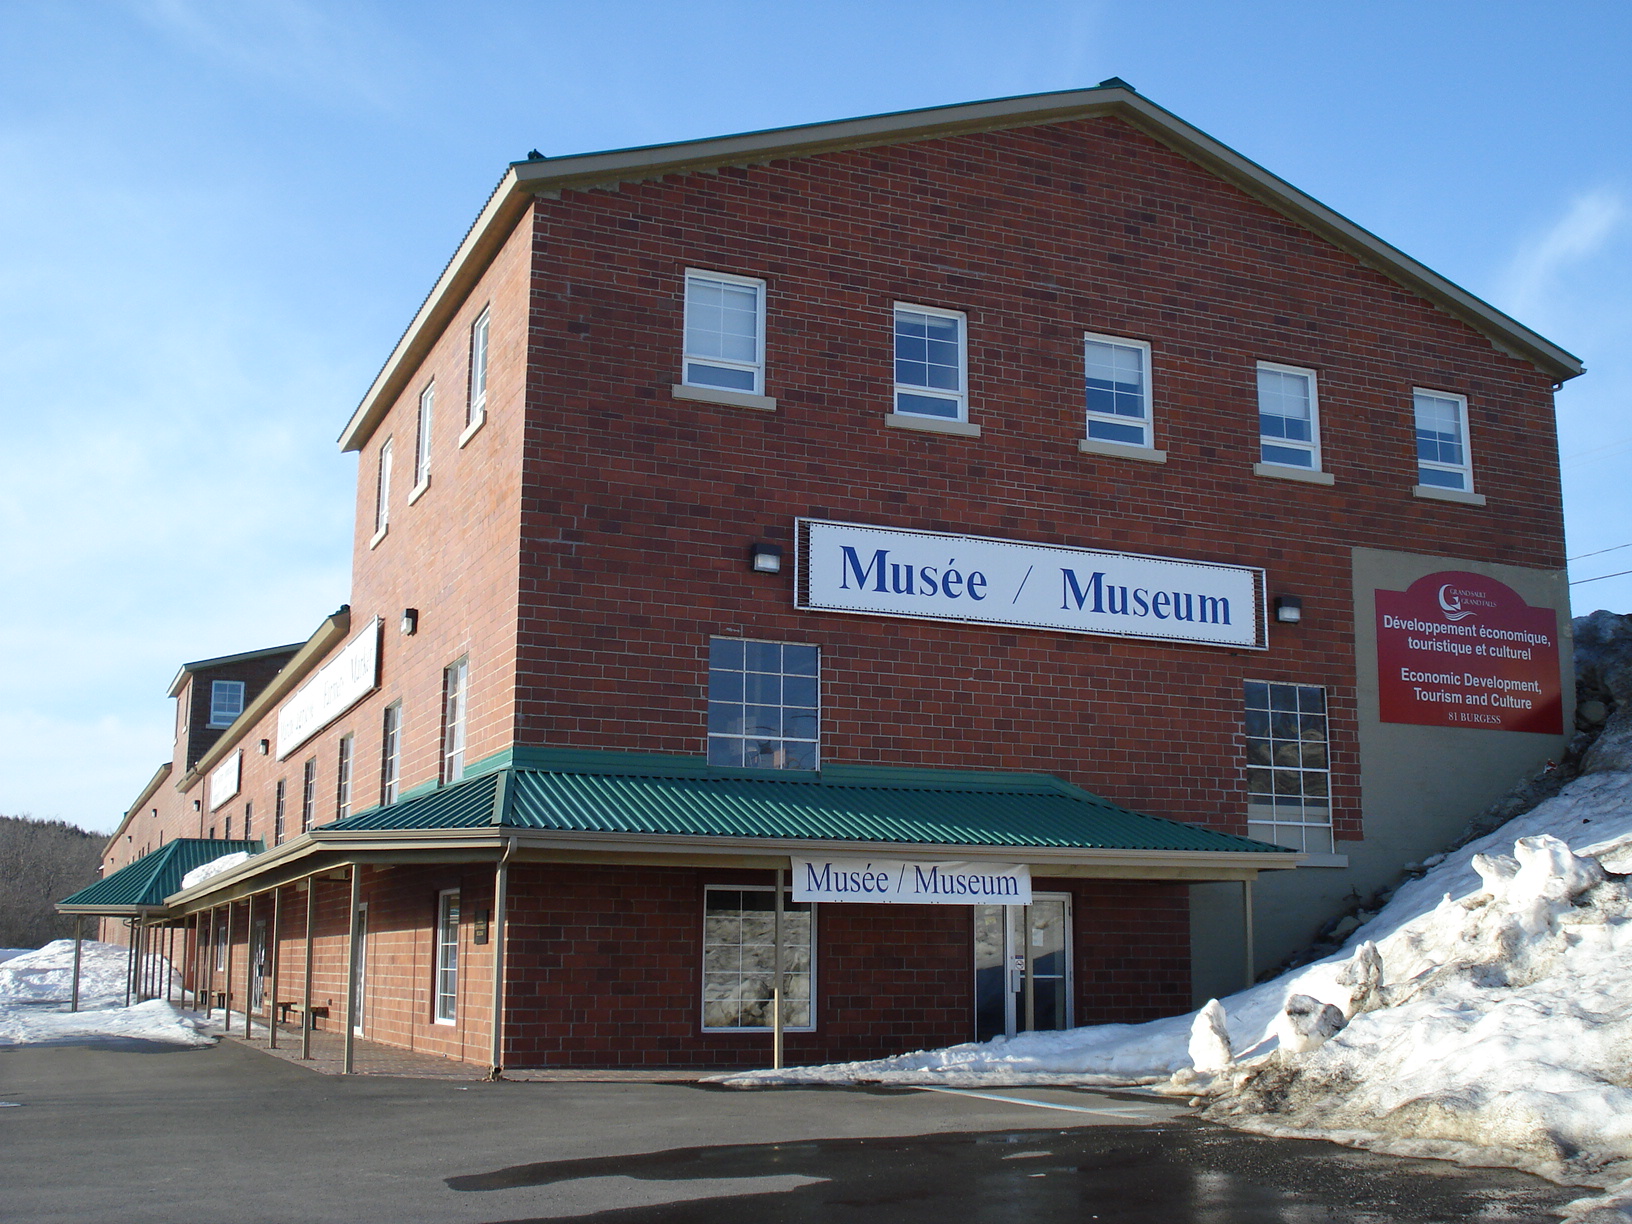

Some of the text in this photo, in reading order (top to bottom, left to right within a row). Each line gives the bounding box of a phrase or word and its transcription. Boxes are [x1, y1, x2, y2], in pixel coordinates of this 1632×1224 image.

[838, 545, 1232, 626] Musée / Museum
[1384, 615, 1551, 647] Développement économique,
[1408, 636, 1532, 660] touristique et culturel
[1401, 667, 1542, 695] Economic Development,
[1414, 687, 1532, 709] Tourism and Culture
[1448, 712, 1501, 724] 81 BURGESS
[804, 862, 1020, 897] Musée / Museum
